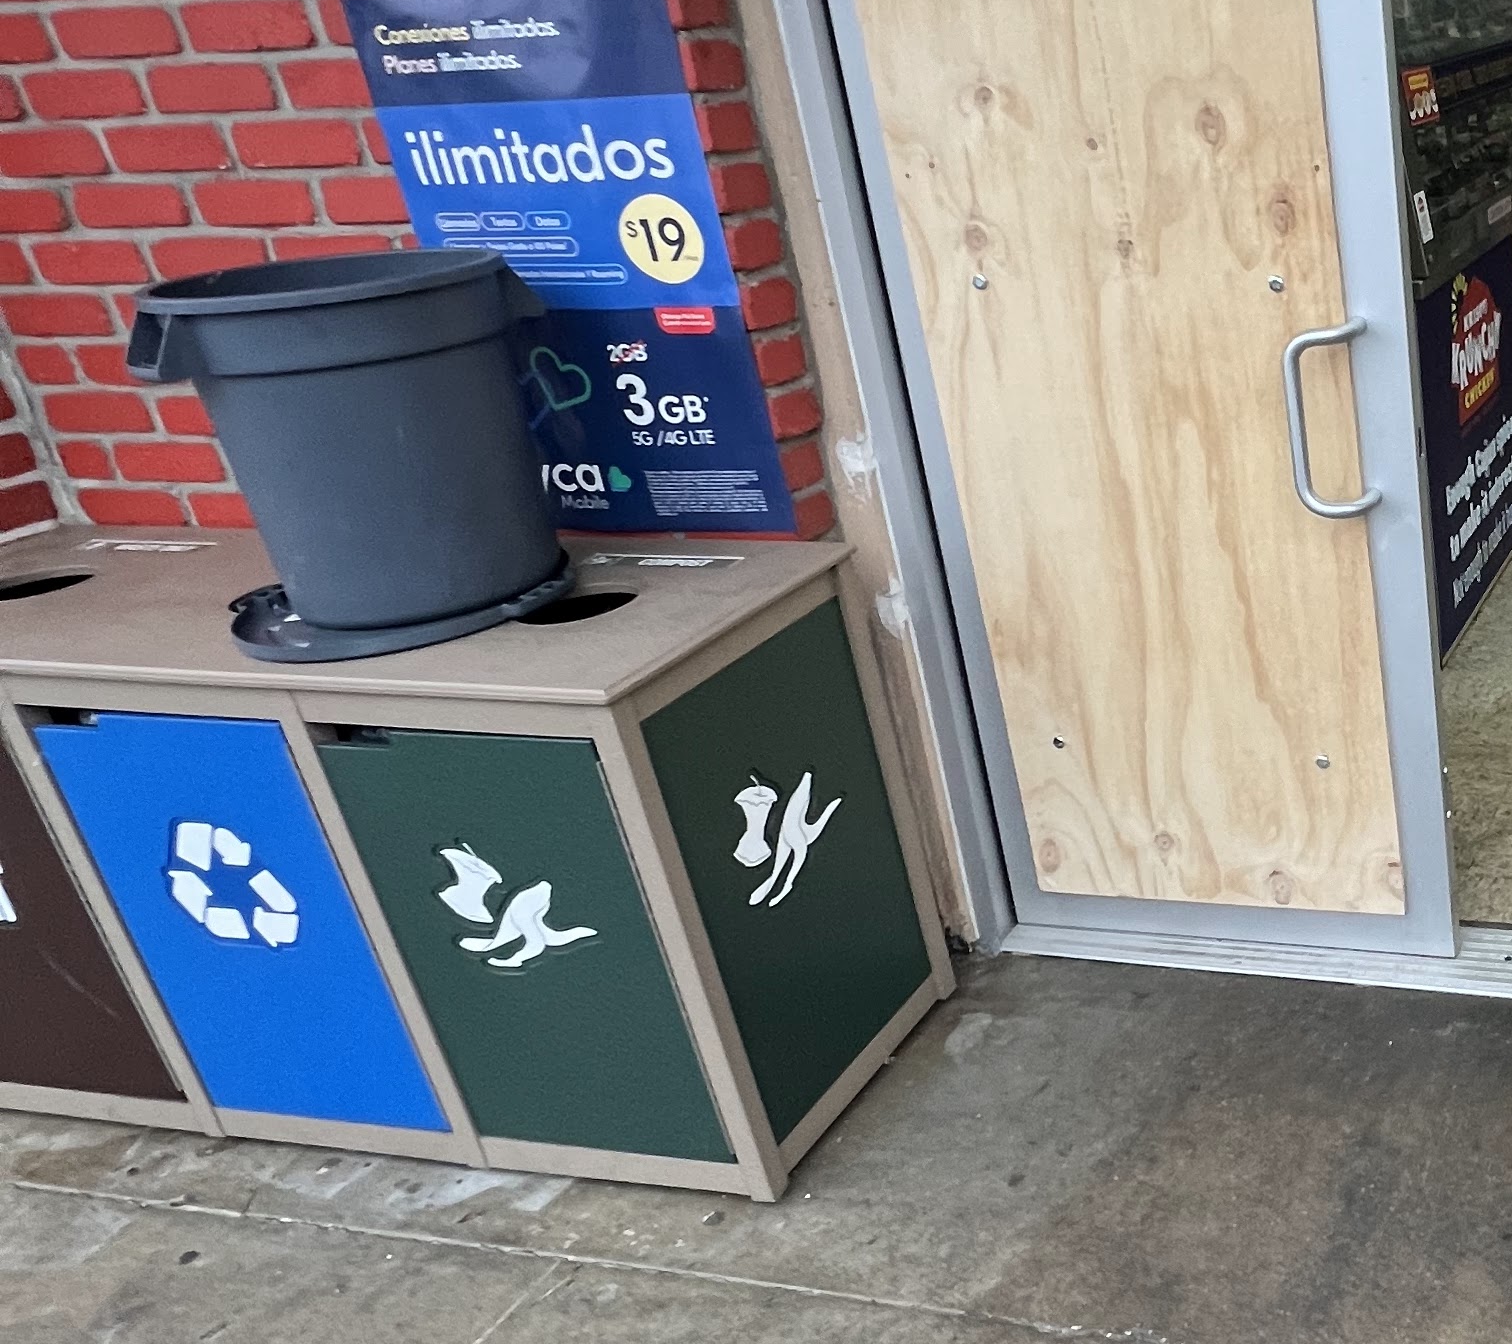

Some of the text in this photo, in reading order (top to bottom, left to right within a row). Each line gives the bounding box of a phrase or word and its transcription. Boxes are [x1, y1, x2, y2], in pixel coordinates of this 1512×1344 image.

[382, 54, 438, 75] Planes
[404, 123, 676, 186] ilimitados
[625, 216, 686, 263] $19
[616, 373, 655, 426] 3
[632, 430, 654, 446] 5G
[688, 429, 716, 445] LTE
[561, 494, 610, 510] Mobile
